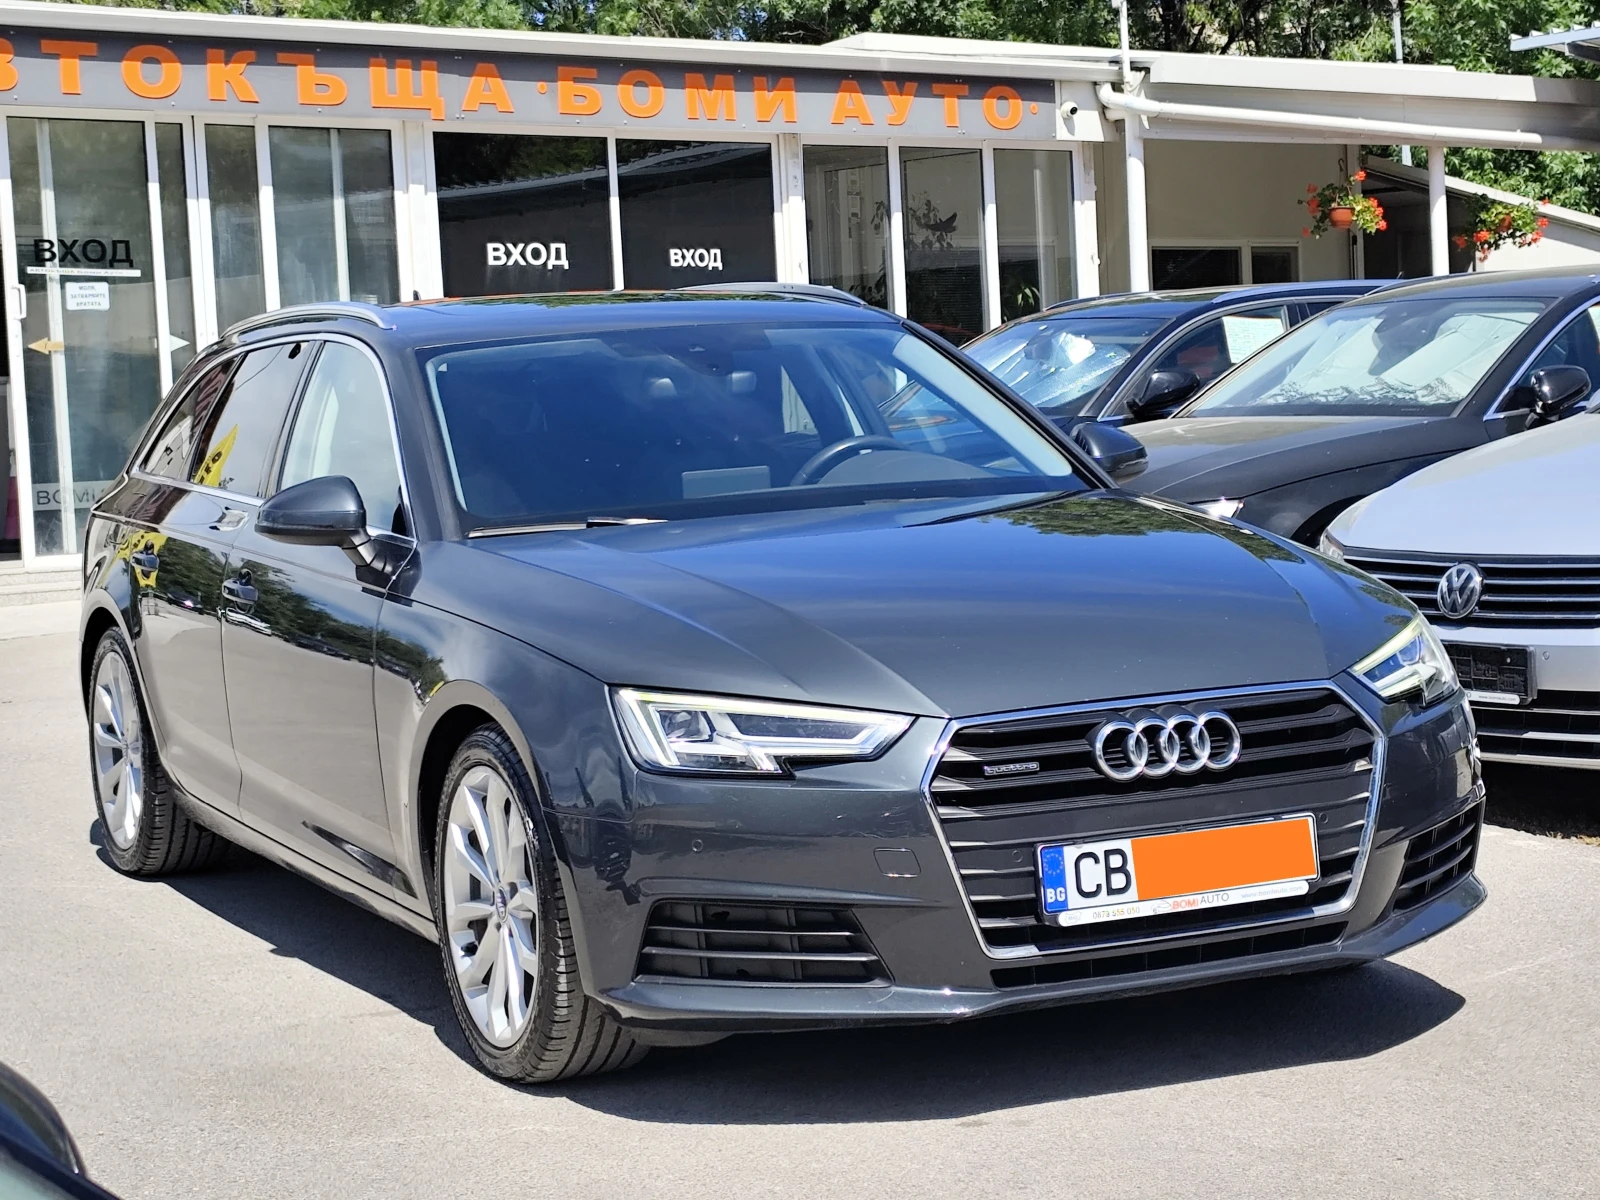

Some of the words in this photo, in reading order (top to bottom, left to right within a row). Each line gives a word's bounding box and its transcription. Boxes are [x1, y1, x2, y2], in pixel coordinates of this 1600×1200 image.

[556, 66, 797, 123] БОМИ
[831, 79, 1024, 130] АУТО
[33, 238, 134, 268] ВХОД
[486, 242, 569, 270] ВХОД
[668, 248, 723, 271] ВХОД
[987, 763, 1037, 774] quattro
[1074, 848, 1132, 899] CB
[1046, 888, 1066, 903] BG
[1172, 898, 1199, 910] BOMI
[1200, 892, 1230, 905] AUTO
